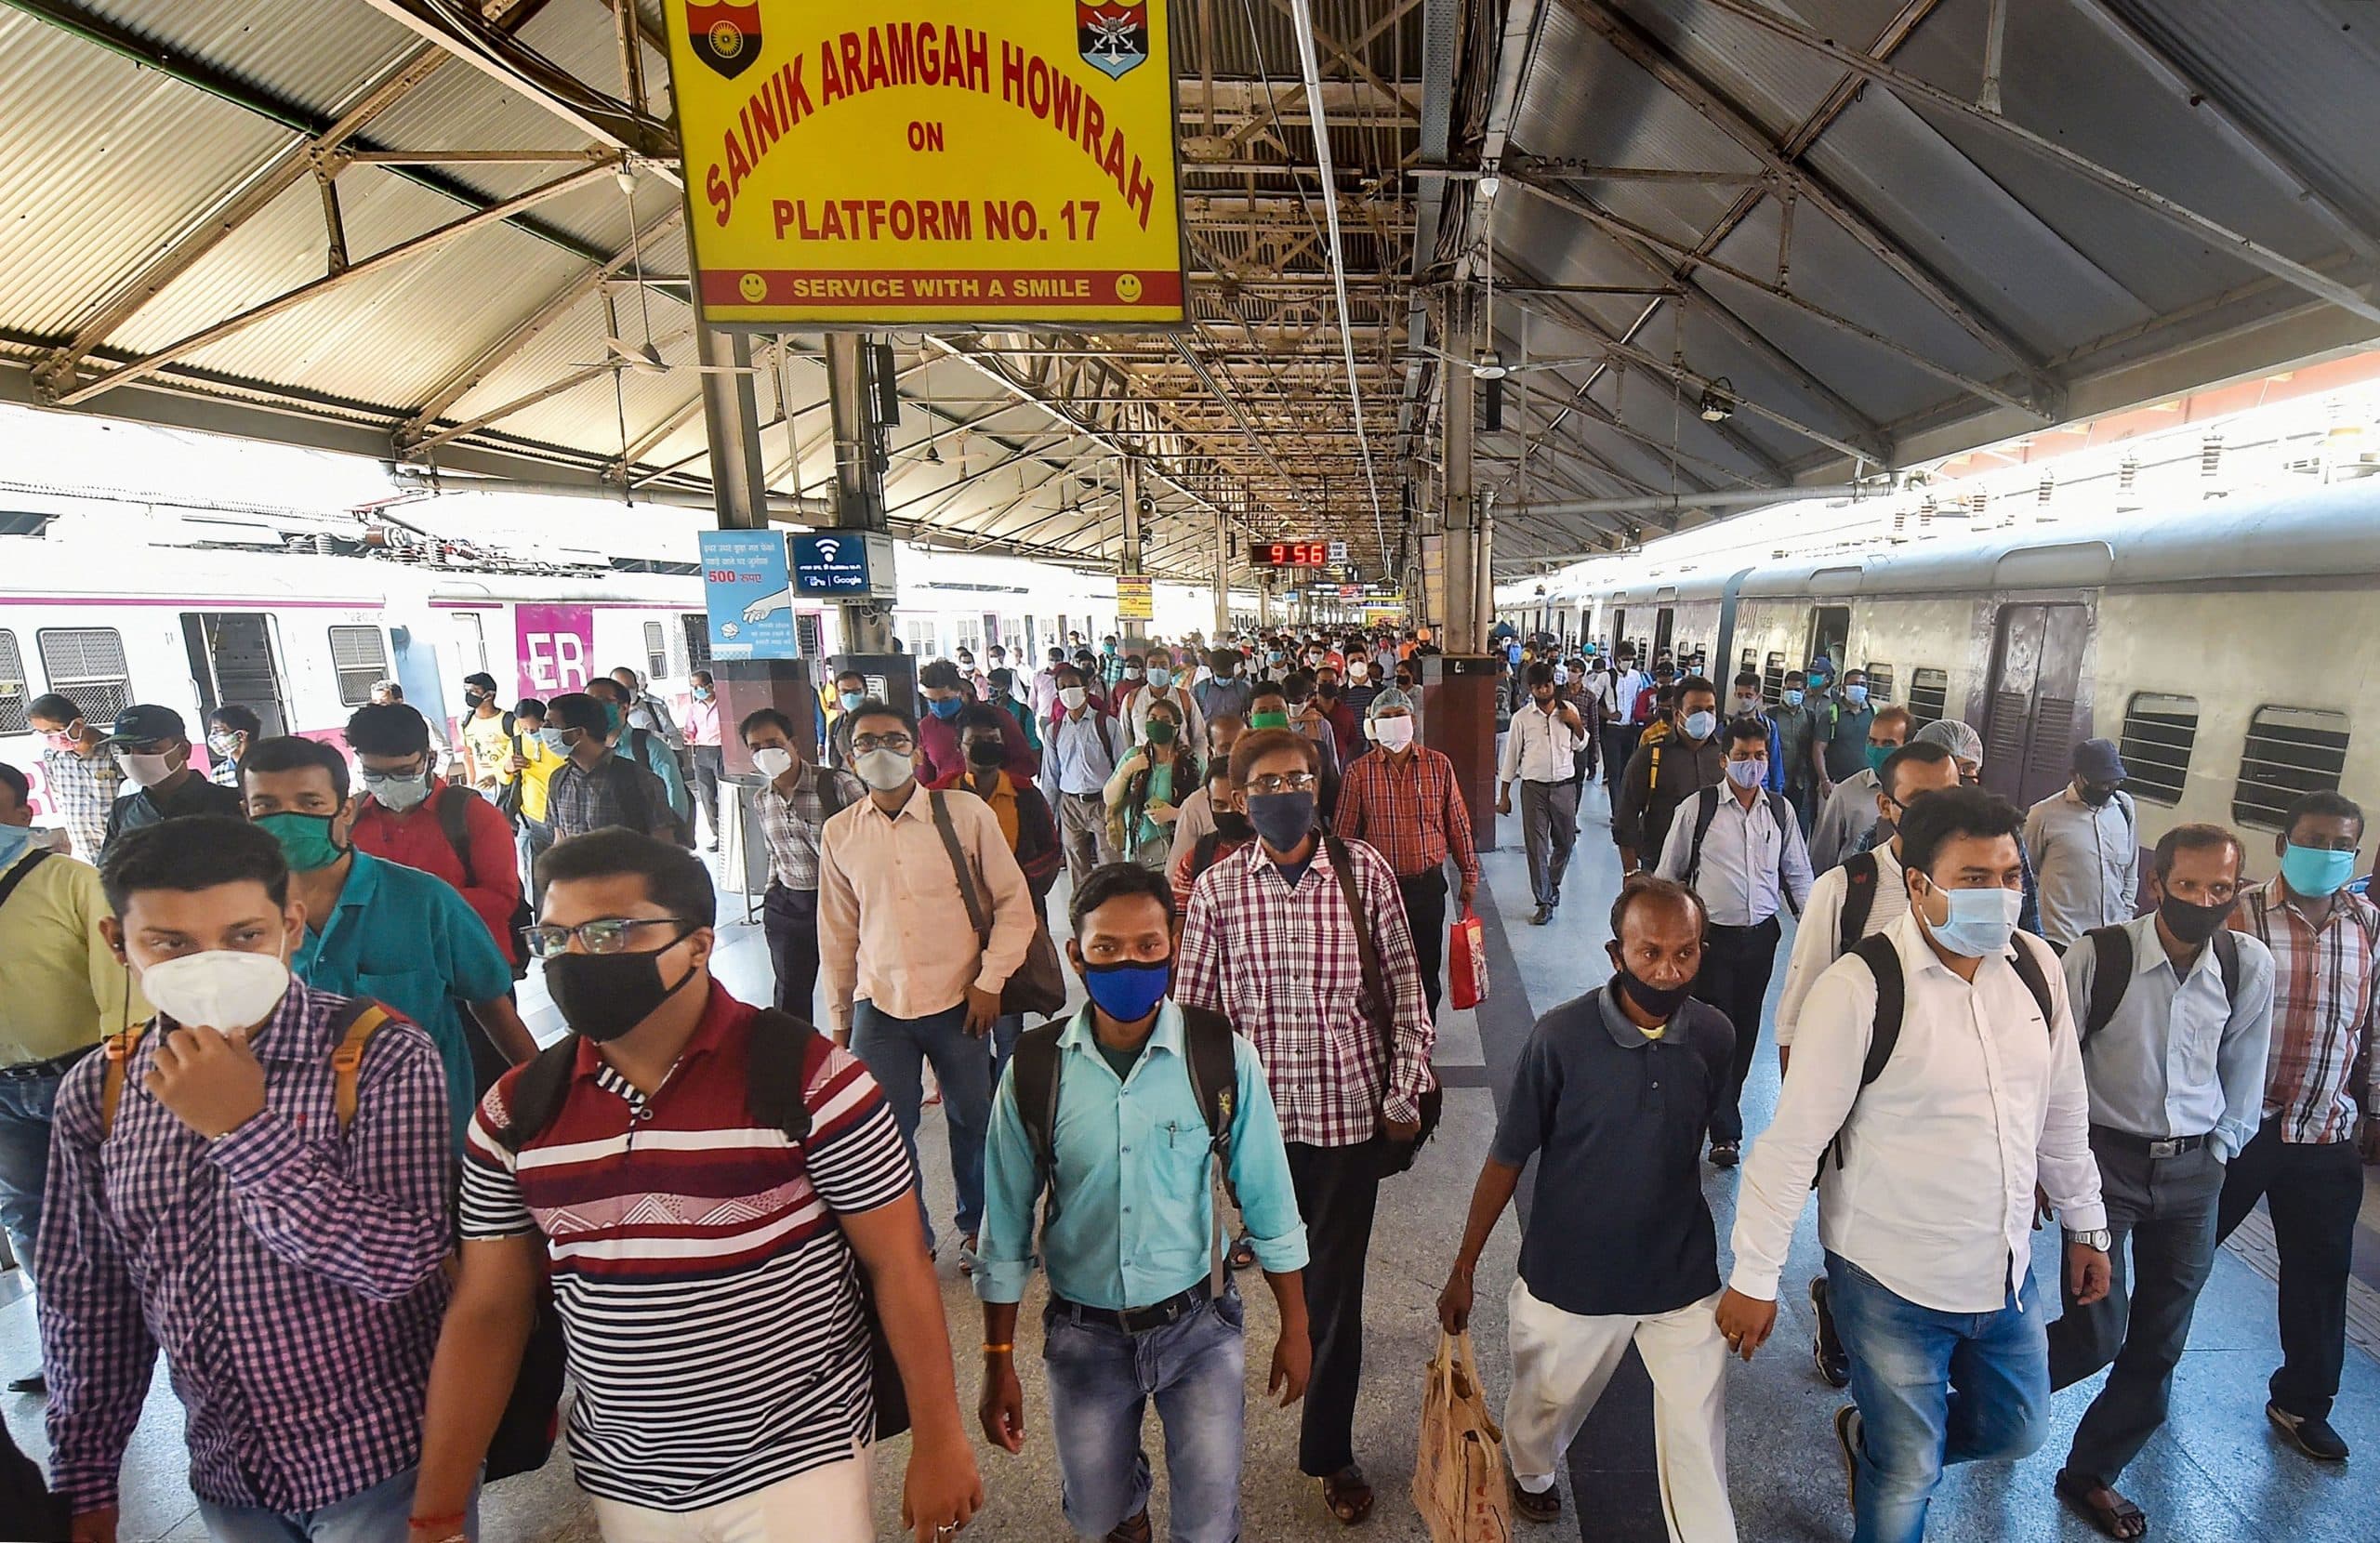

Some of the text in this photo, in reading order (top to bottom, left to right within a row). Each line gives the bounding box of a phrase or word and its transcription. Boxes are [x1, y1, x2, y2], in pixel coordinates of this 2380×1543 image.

[706, 21, 1155, 232] SAINIK ARAMGAH HOWRAH
[907, 120, 944, 152] ON
[772, 199, 1101, 242] PLATFORM NO. 17
[793, 278, 1091, 298] SERVICE WITH A SMILE
[707, 570, 736, 583] 500
[833, 575, 862, 586] Google
[526, 632, 588, 691] ER
